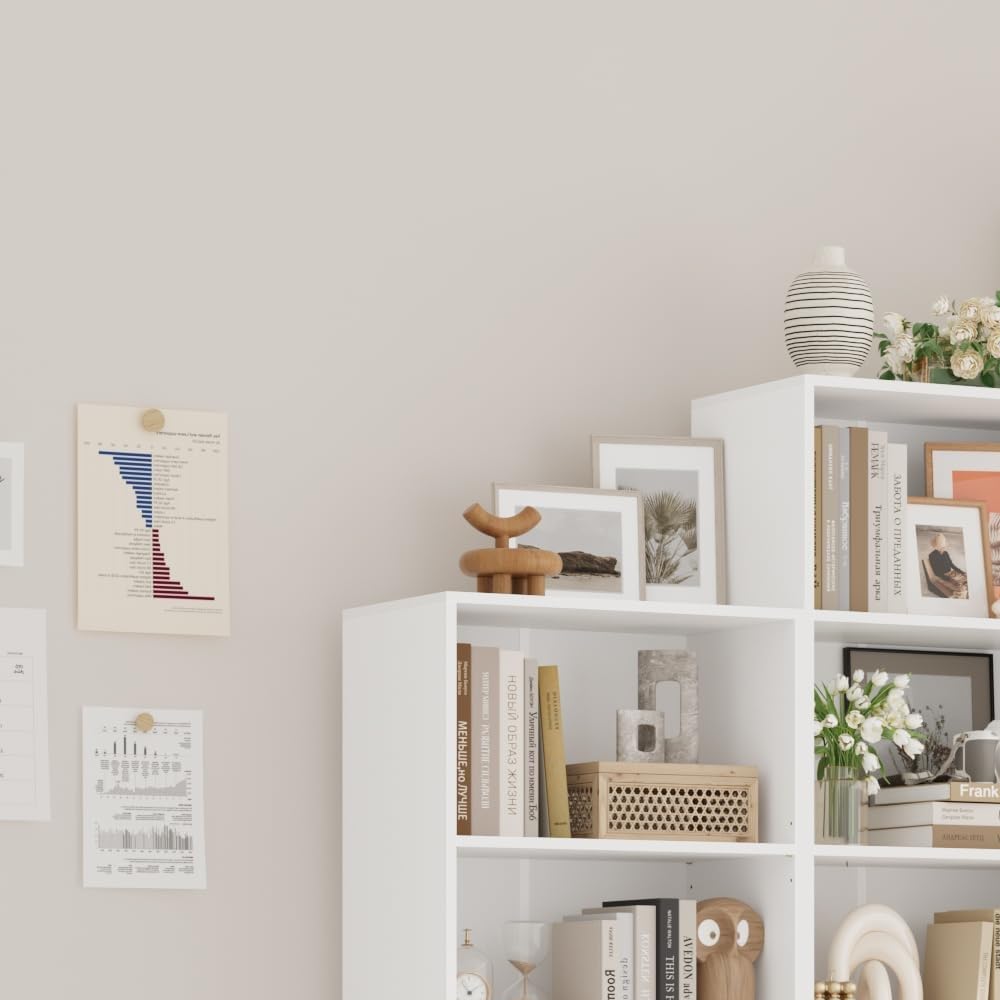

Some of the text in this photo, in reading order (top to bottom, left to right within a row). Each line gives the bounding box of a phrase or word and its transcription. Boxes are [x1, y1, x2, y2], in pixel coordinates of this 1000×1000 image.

[872, 505, 882, 601] Триумфальная арка
[893, 474, 902, 596] ЗАБОТА ПРЕДАННЫХ
[507, 675, 519, 816] НОВЫЙ ОБРАЗ ЖИЗНИ
[527, 711, 538, 748] Уличный
[528, 766, 535, 776] по
[458, 783, 467, 821] ЛУЧШЕ
[959, 783, 999, 798] Frank
[528, 804, 538, 821] Боб
[665, 955, 675, 980] THIS
[683, 936, 693, 980] AVEDON
[665, 983, 675, 993] IS
